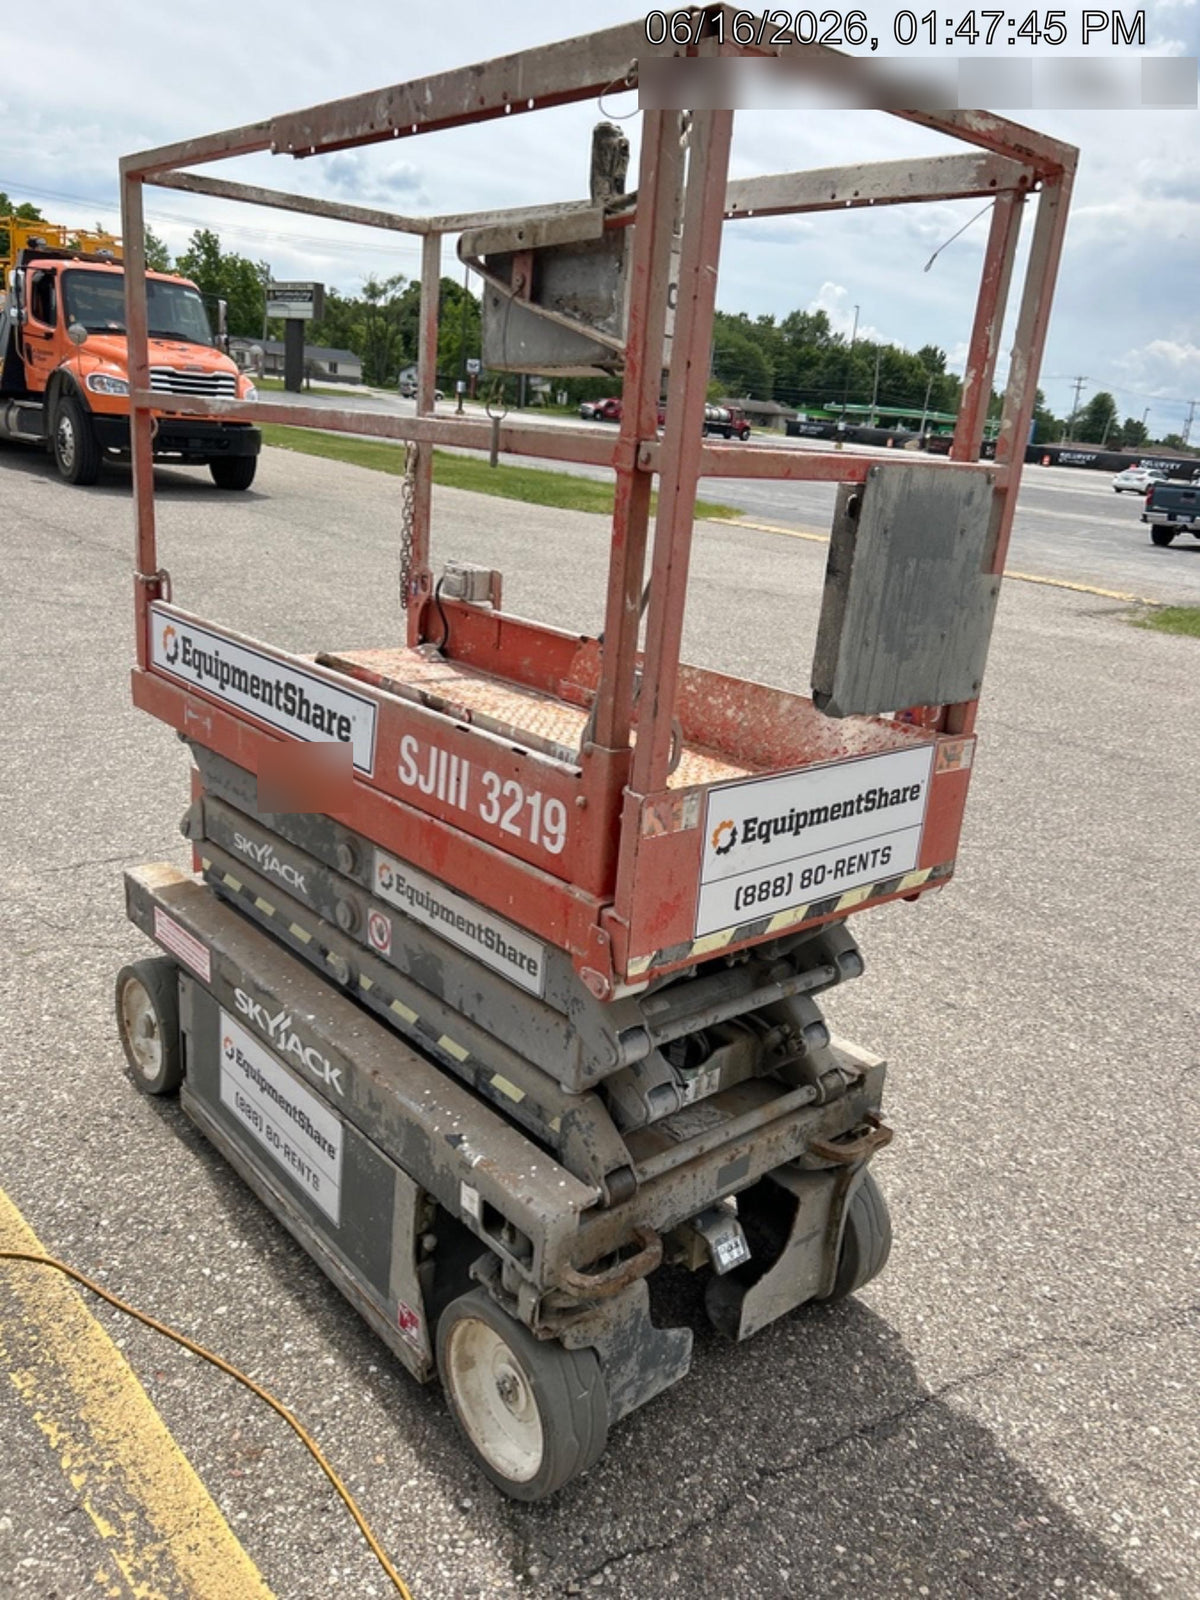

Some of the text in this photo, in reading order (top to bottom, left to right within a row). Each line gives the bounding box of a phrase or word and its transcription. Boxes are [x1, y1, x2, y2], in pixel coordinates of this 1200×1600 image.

[181, 635, 352, 743] EquipmentShare
[398, 735, 567, 854] SJIII 3219
[741, 782, 921, 844] EquipmentShare
[233, 832, 308, 894] SKYJACK
[734, 846, 892, 911] (888) 80-RENTS
[396, 873, 538, 978] EquipmentShare
[234, 987, 345, 1096] SKYJACK
[234, 1091, 321, 1192] (888) 80-RENTS
[235, 1047, 336, 1160] EquipmentShare
